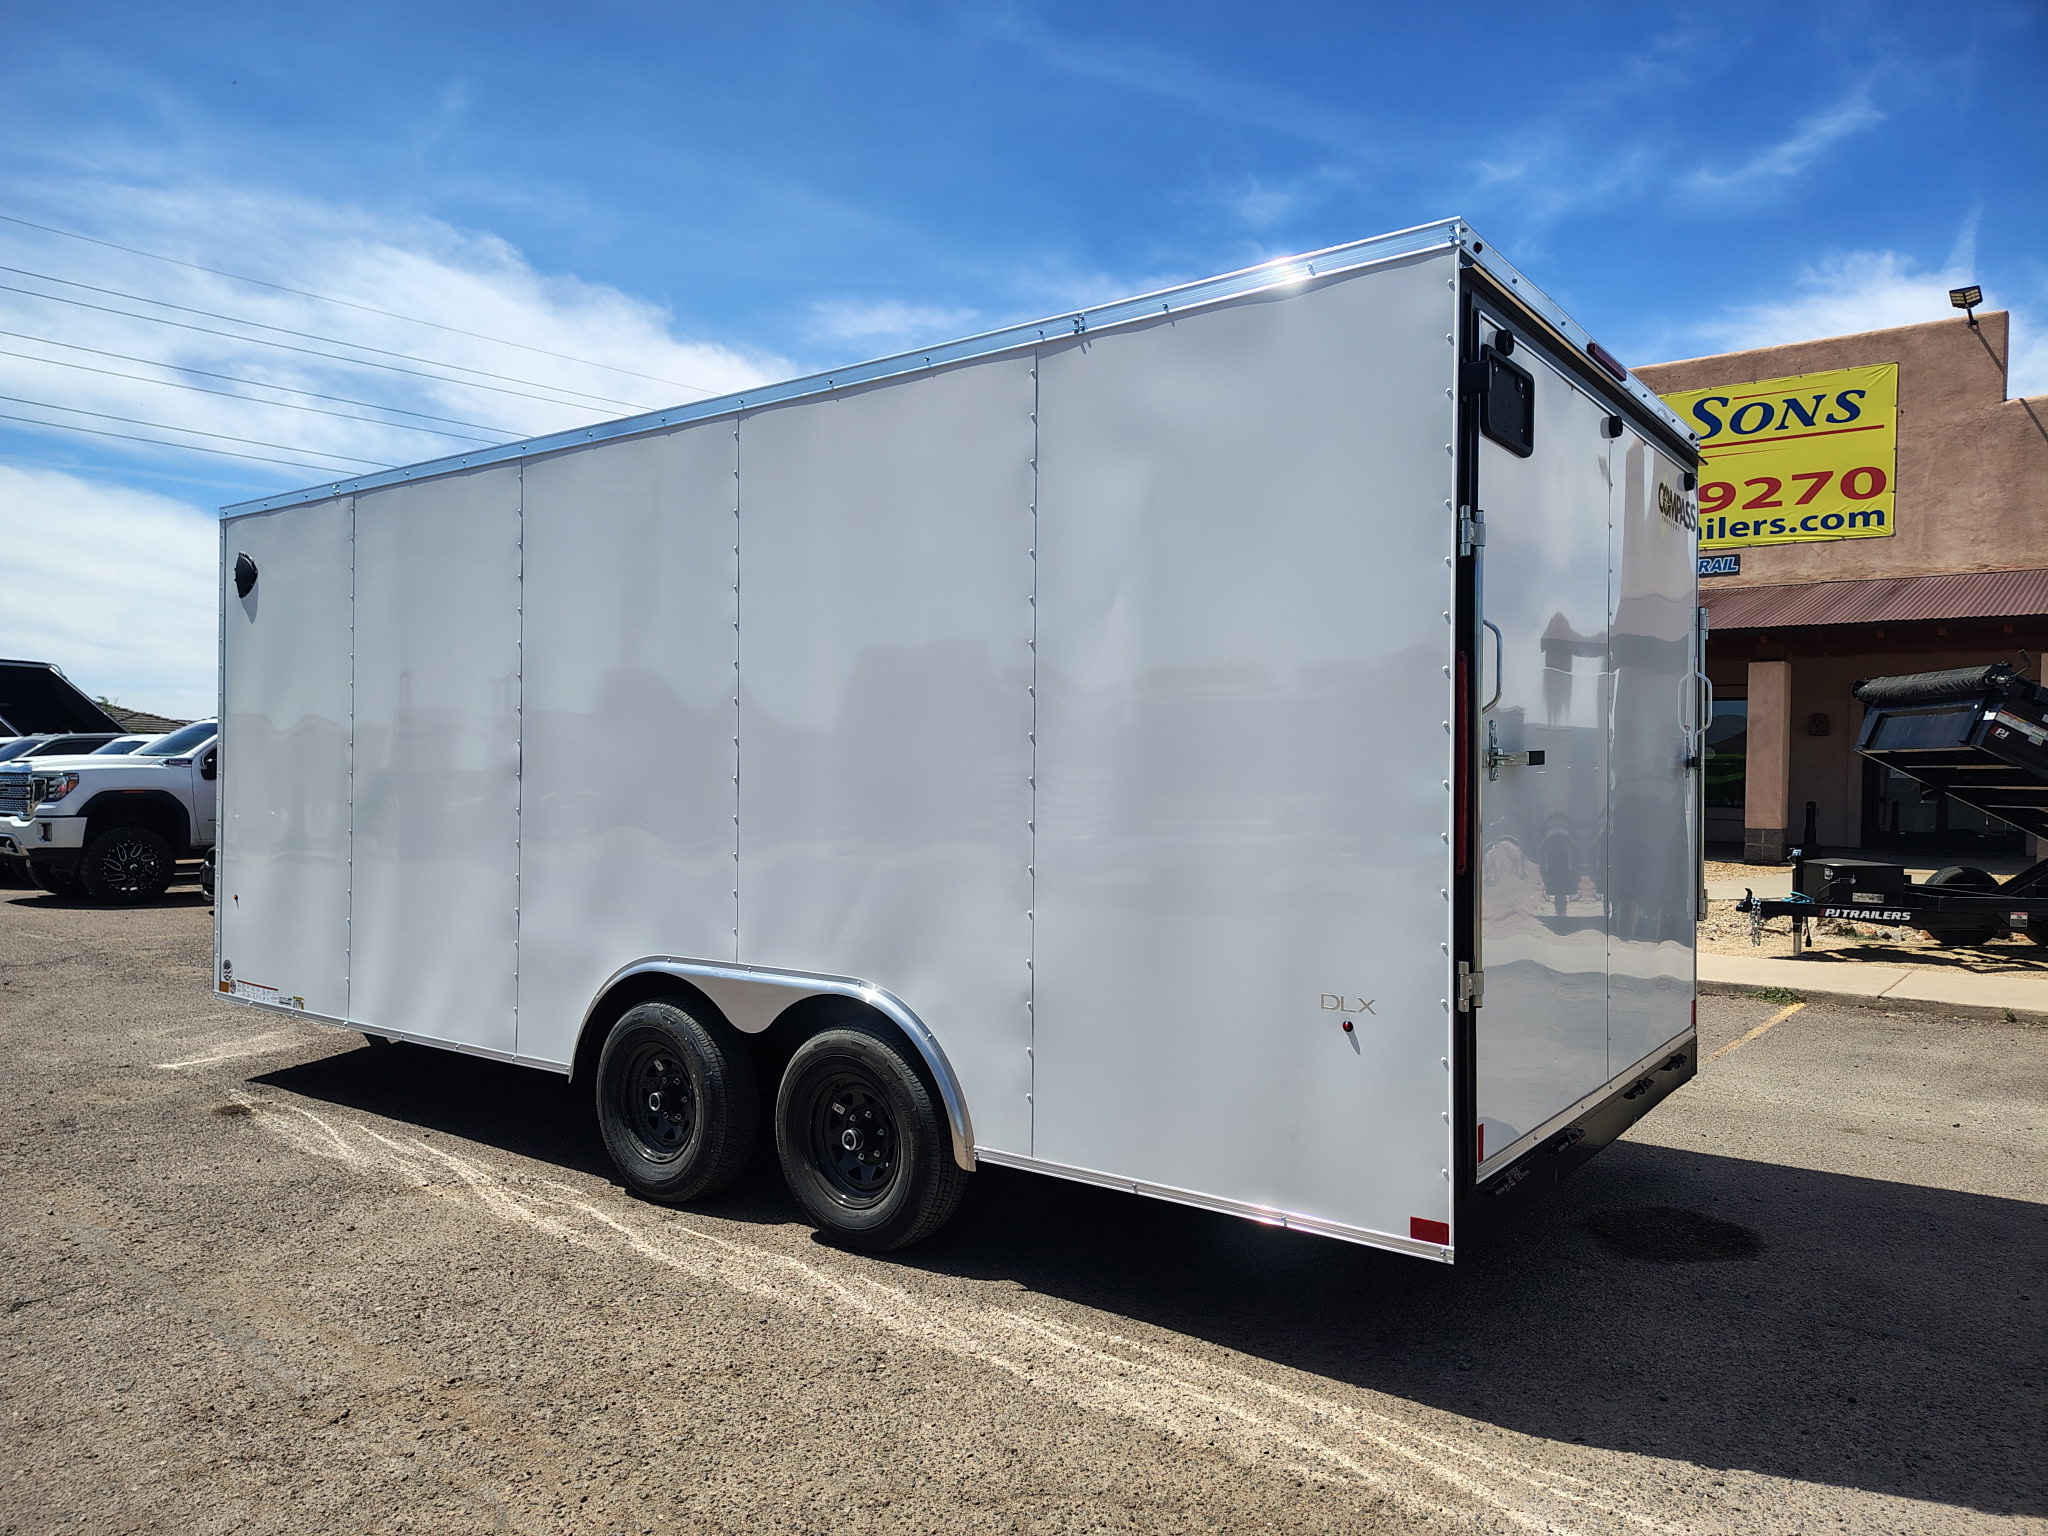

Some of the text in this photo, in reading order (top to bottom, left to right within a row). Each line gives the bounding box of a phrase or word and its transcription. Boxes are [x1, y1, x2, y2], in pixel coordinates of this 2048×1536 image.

[1698, 467, 1887, 514] 9270
[1658, 481, 1696, 532] COMPASS
[1698, 509, 1885, 540] ilers.com
[1841, 909, 1912, 920] TRAILERS
[1320, 993, 1377, 1016] DLX
